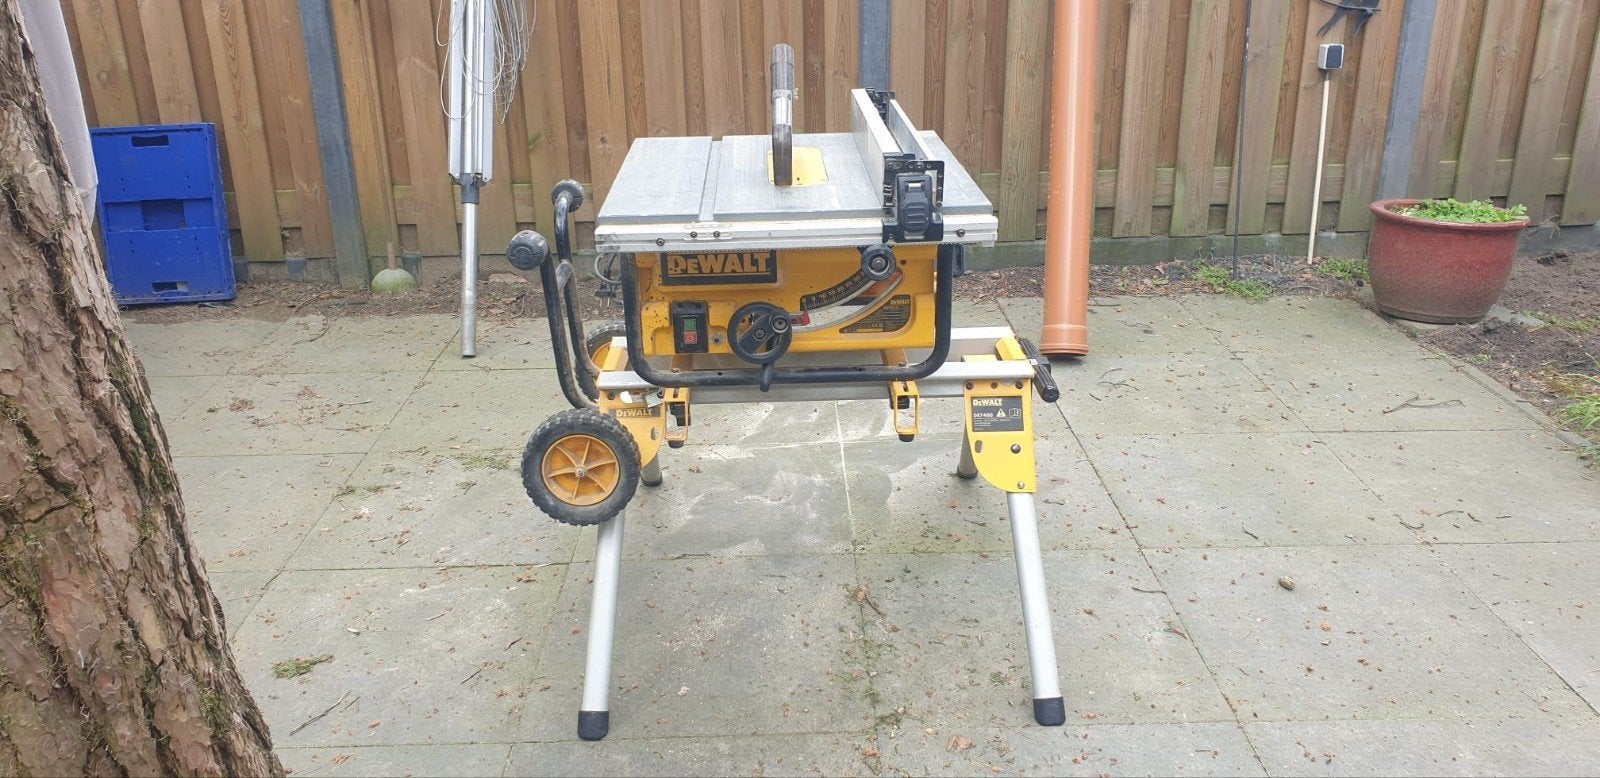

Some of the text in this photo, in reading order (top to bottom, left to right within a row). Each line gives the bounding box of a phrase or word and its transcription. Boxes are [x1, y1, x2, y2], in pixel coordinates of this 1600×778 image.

[667, 252, 771, 276] DEWALT
[973, 398, 1003, 406] DEWALT
[616, 408, 653, 417] DEWALT
